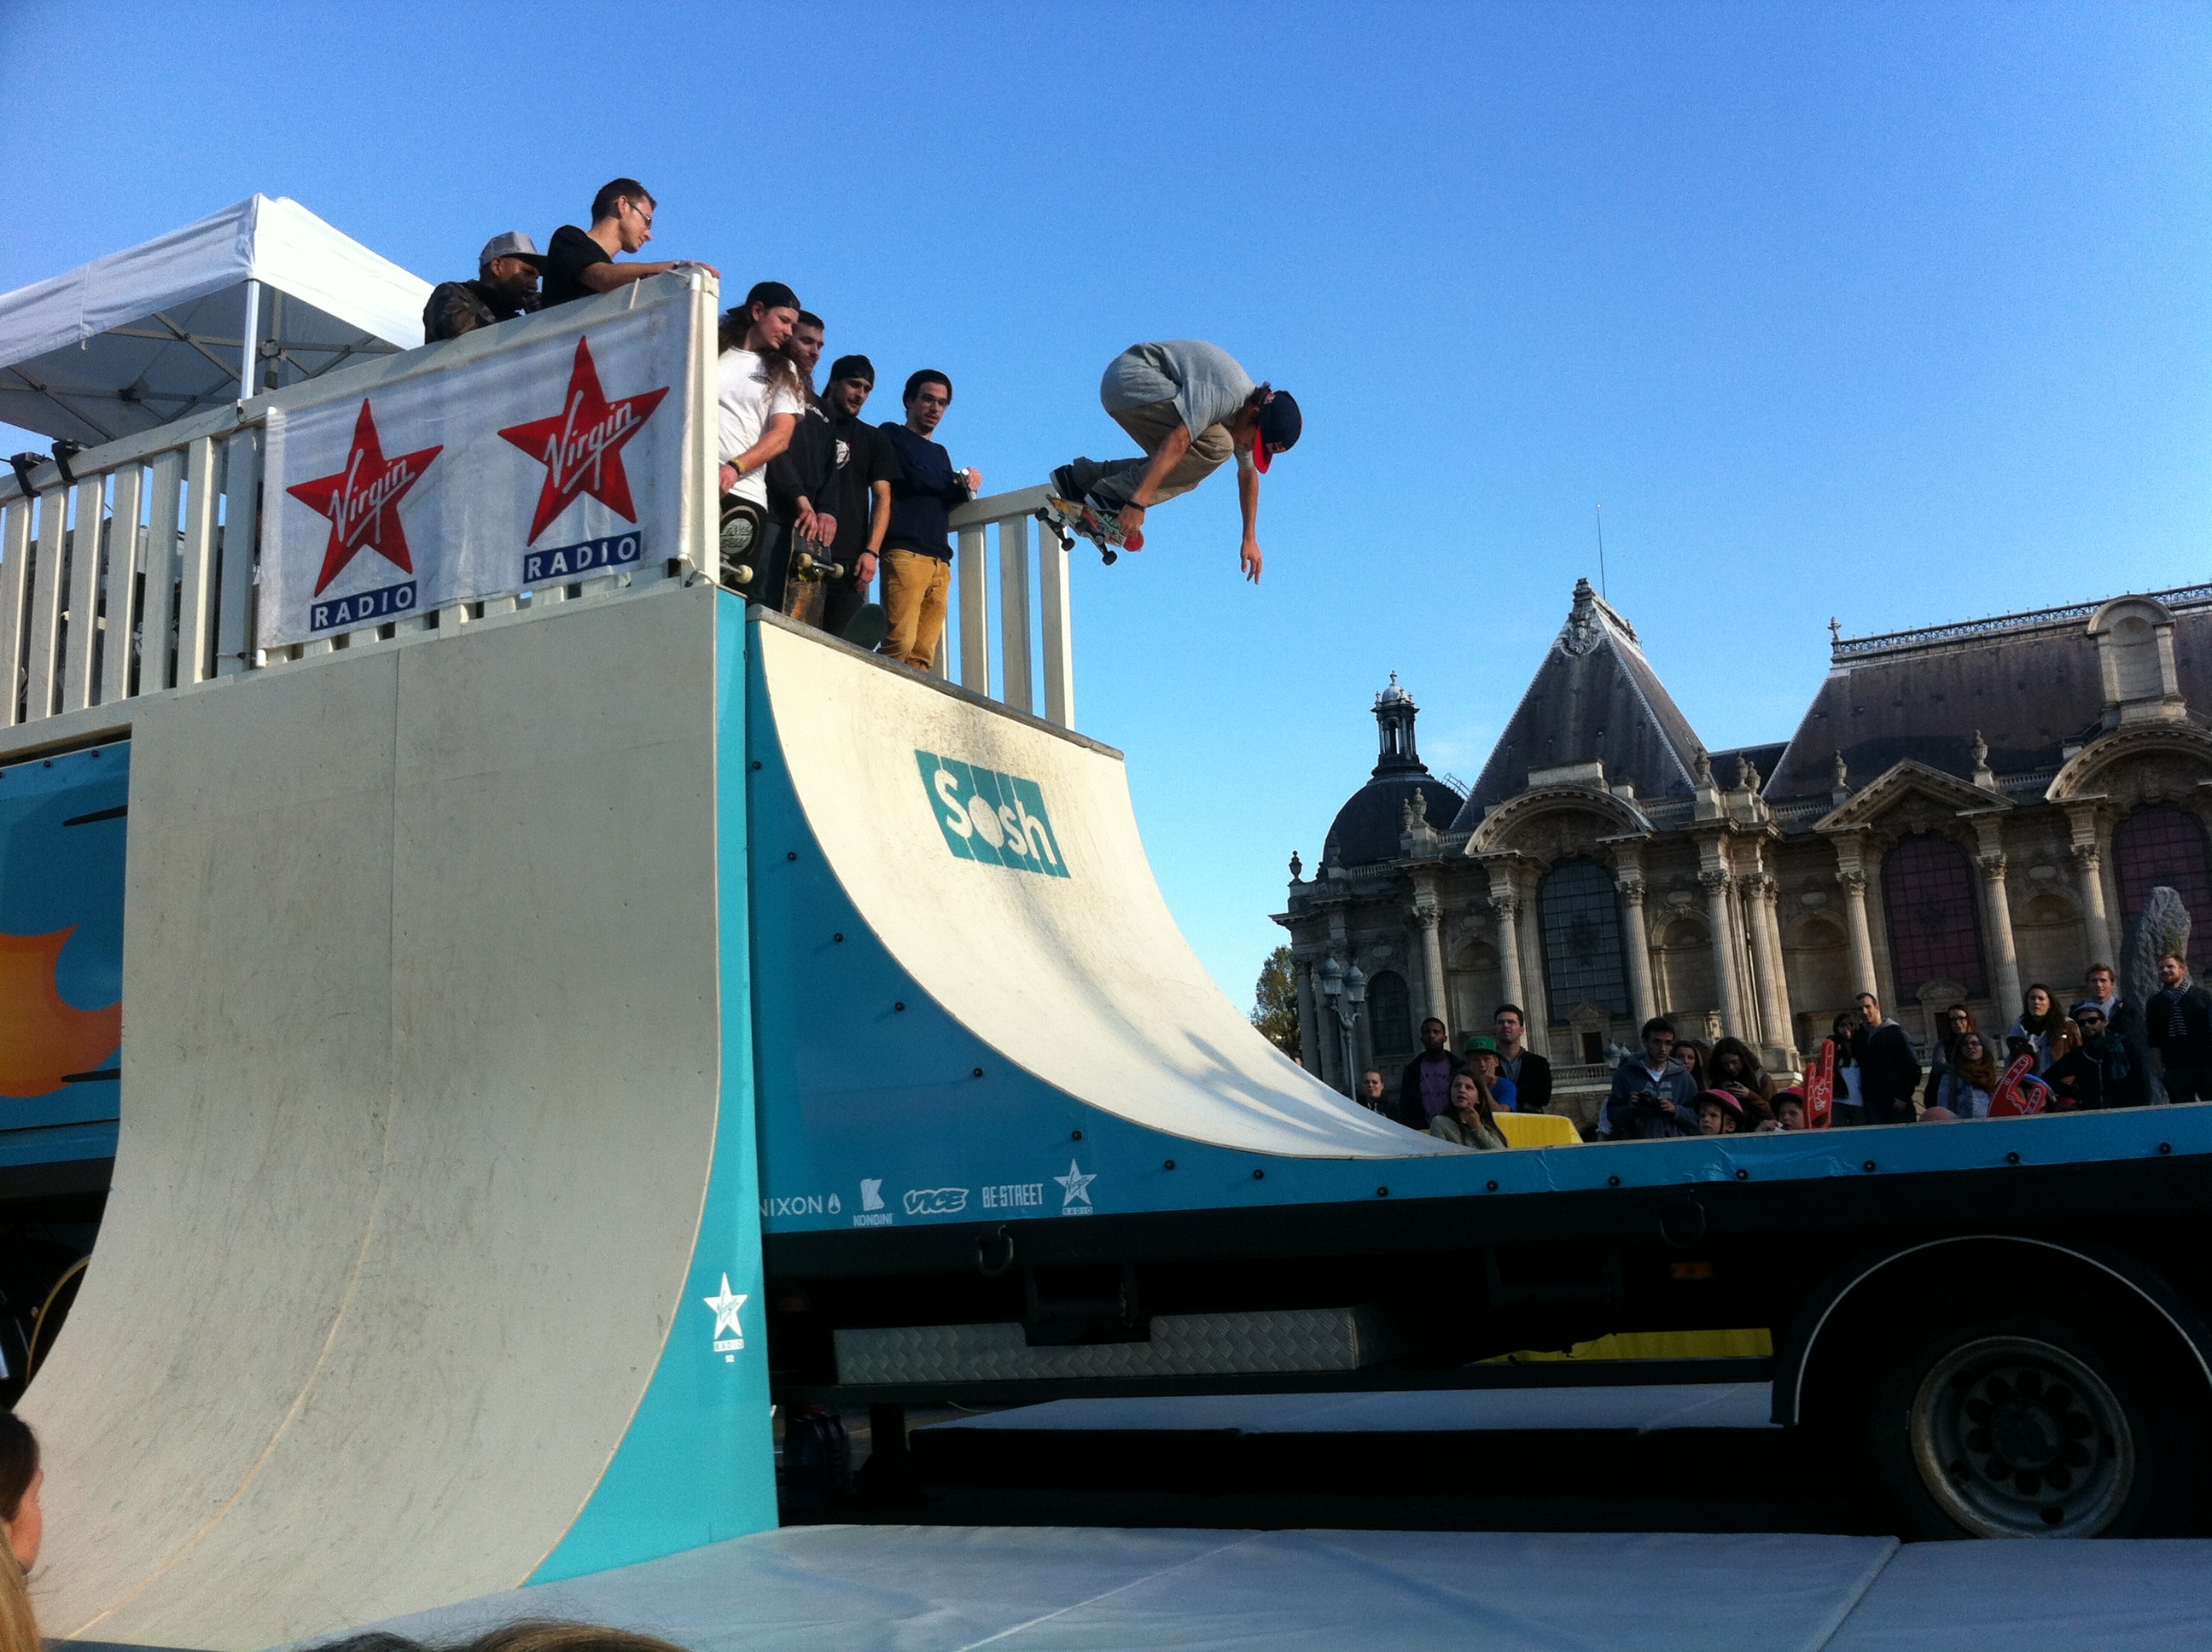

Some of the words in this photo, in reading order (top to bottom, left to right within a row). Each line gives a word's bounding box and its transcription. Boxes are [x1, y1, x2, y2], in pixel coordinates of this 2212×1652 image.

[544, 389, 642, 494] Virgin
[328, 448, 416, 548] Virgin
[527, 537, 637, 579] RADIO
[314, 585, 413, 628] RADIO
[934, 769, 1058, 865] Sosh
[759, 1195, 823, 1217] NIXON
[903, 1187, 969, 1215] VICE
